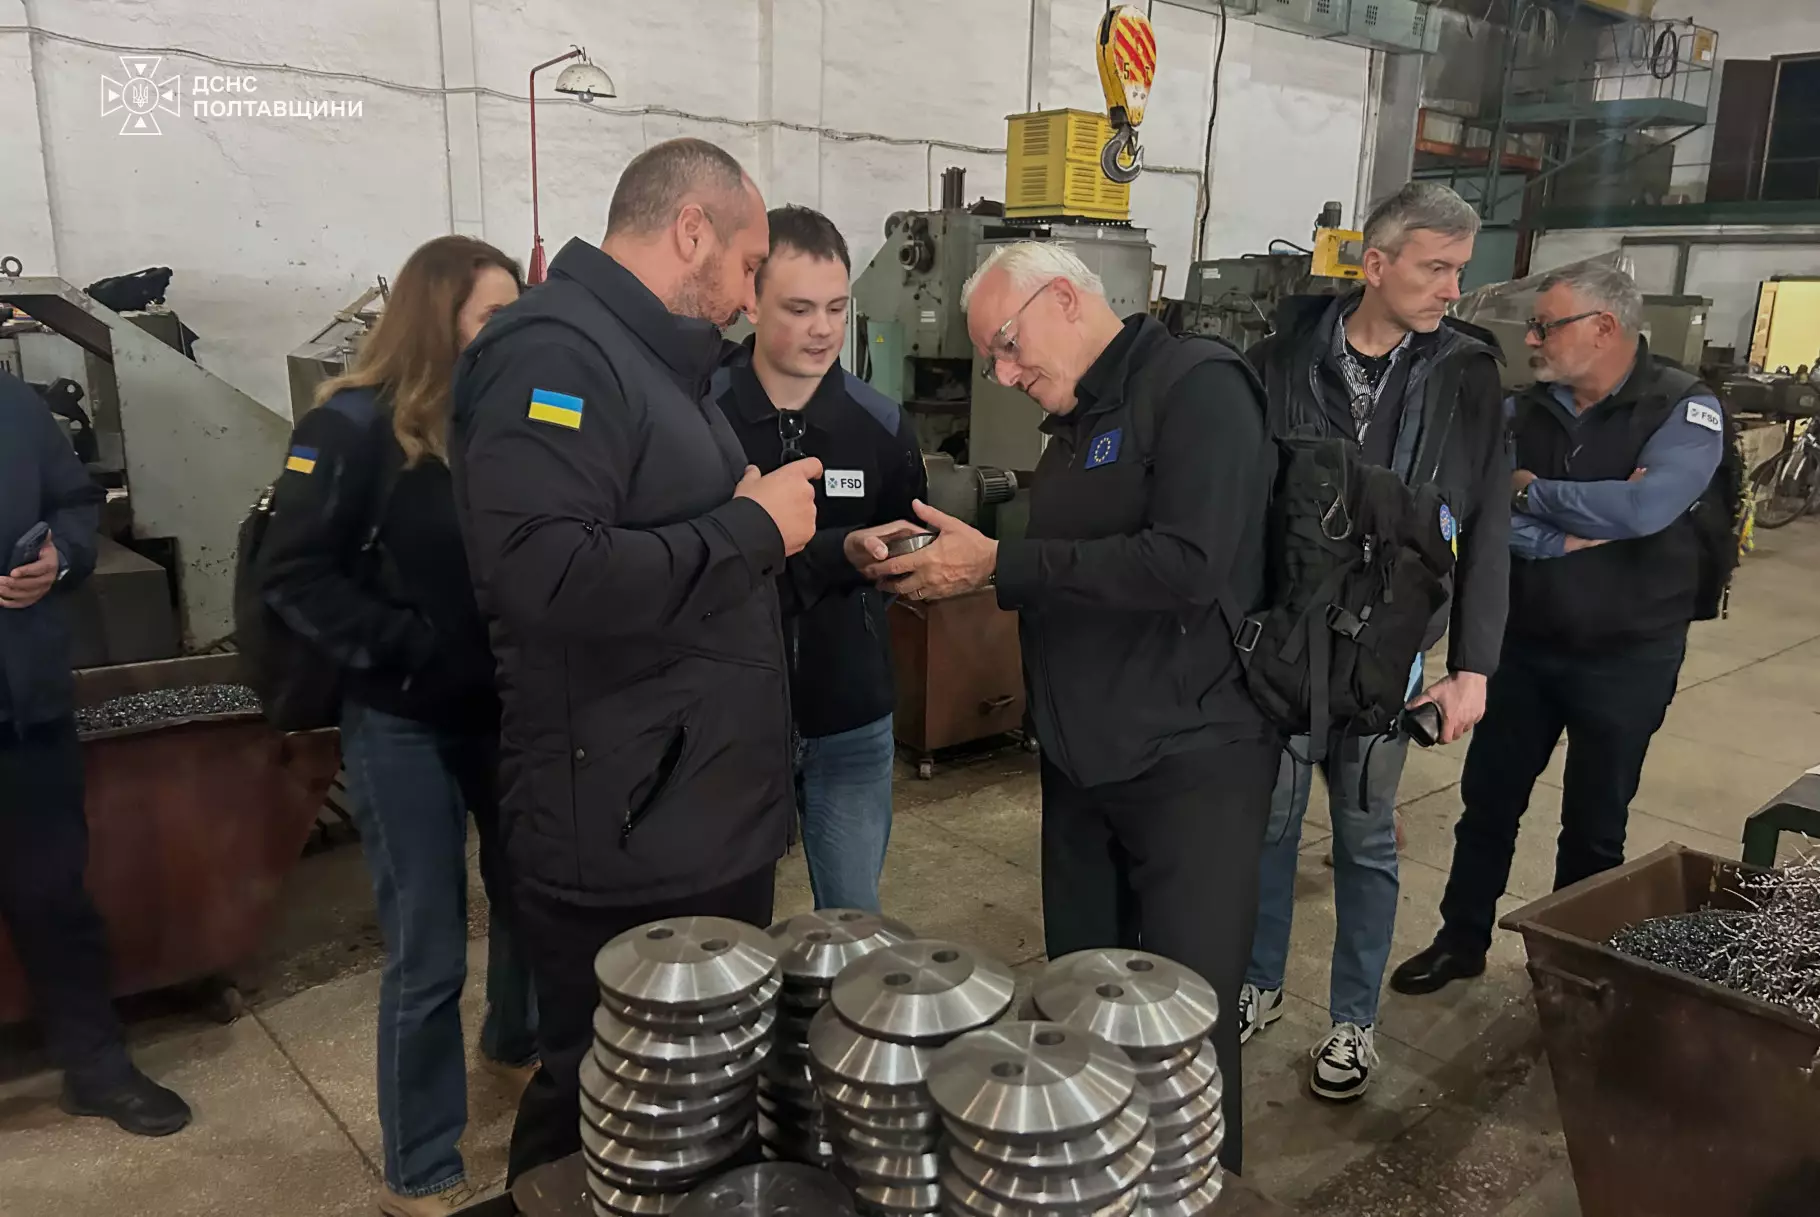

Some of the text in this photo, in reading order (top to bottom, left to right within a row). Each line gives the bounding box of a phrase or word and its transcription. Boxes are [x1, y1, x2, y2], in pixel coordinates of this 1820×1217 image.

[1123, 62, 1130, 80] 5
[1701, 411, 1719, 425] FSD
[840, 478, 862, 489] FSD
